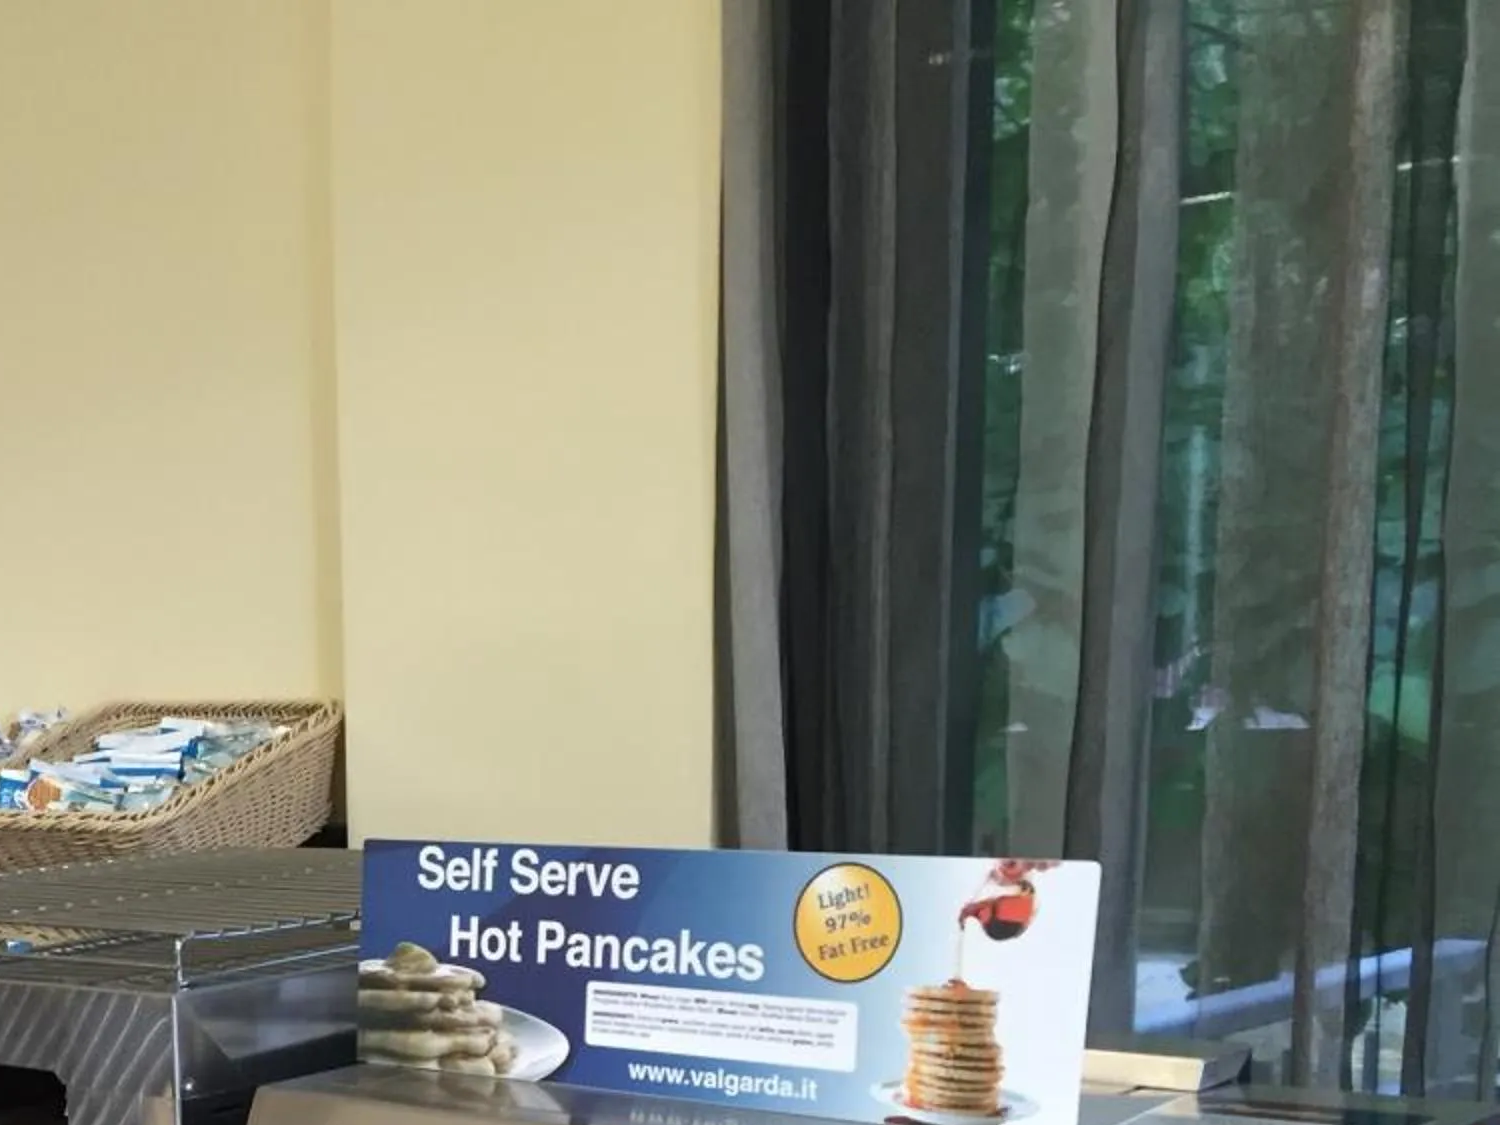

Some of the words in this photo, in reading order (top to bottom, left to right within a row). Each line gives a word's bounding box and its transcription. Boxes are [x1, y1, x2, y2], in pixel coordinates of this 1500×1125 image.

[417, 845, 498, 892] Self
[510, 848, 640, 900] Serve
[818, 883, 869, 910] Light!
[825, 911, 871, 933] 97%
[450, 915, 523, 963] Hot
[536, 919, 765, 981] Pancakes
[818, 943, 846, 961] Fat
[850, 934, 889, 954] Free
[627, 1062, 818, 1101] www.valgarda.it
